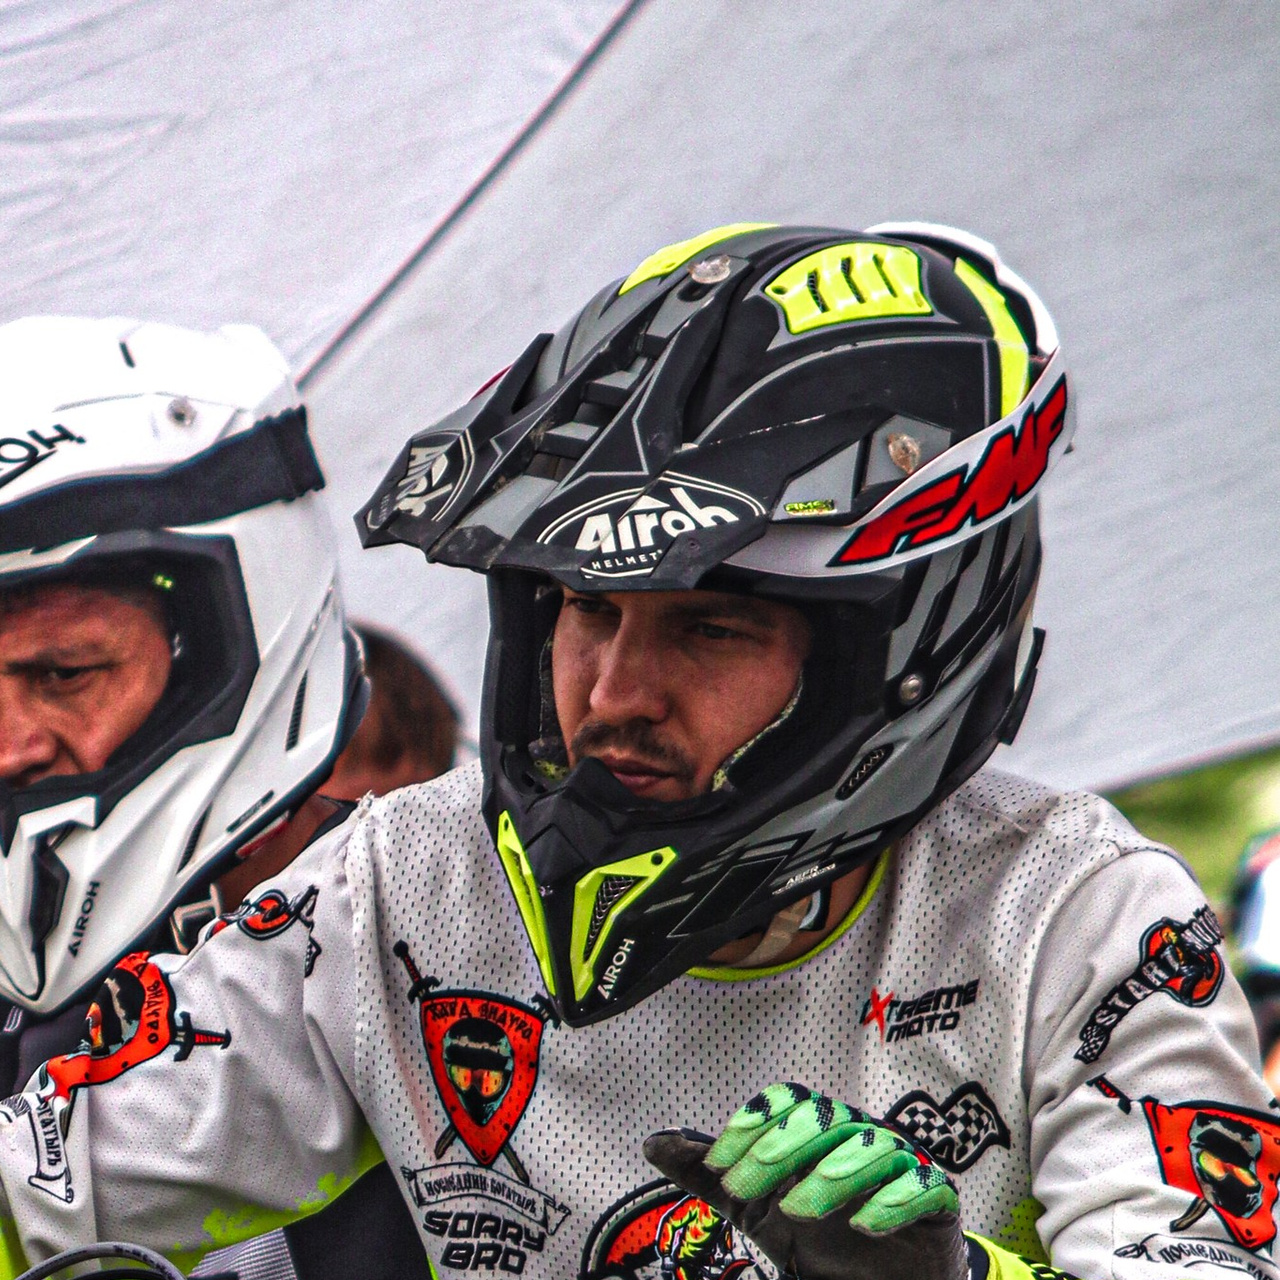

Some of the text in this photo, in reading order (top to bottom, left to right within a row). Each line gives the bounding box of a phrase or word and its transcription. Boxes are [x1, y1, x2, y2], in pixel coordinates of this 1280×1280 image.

[825, 372, 1068, 568] FMF
[68, 880, 101, 958] AIROH
[597, 938, 635, 1000] AIROH
[886, 1010, 960, 1043] MOTO
[423, 1210, 546, 1253] SORRY
[440, 1241, 528, 1276] BRO
